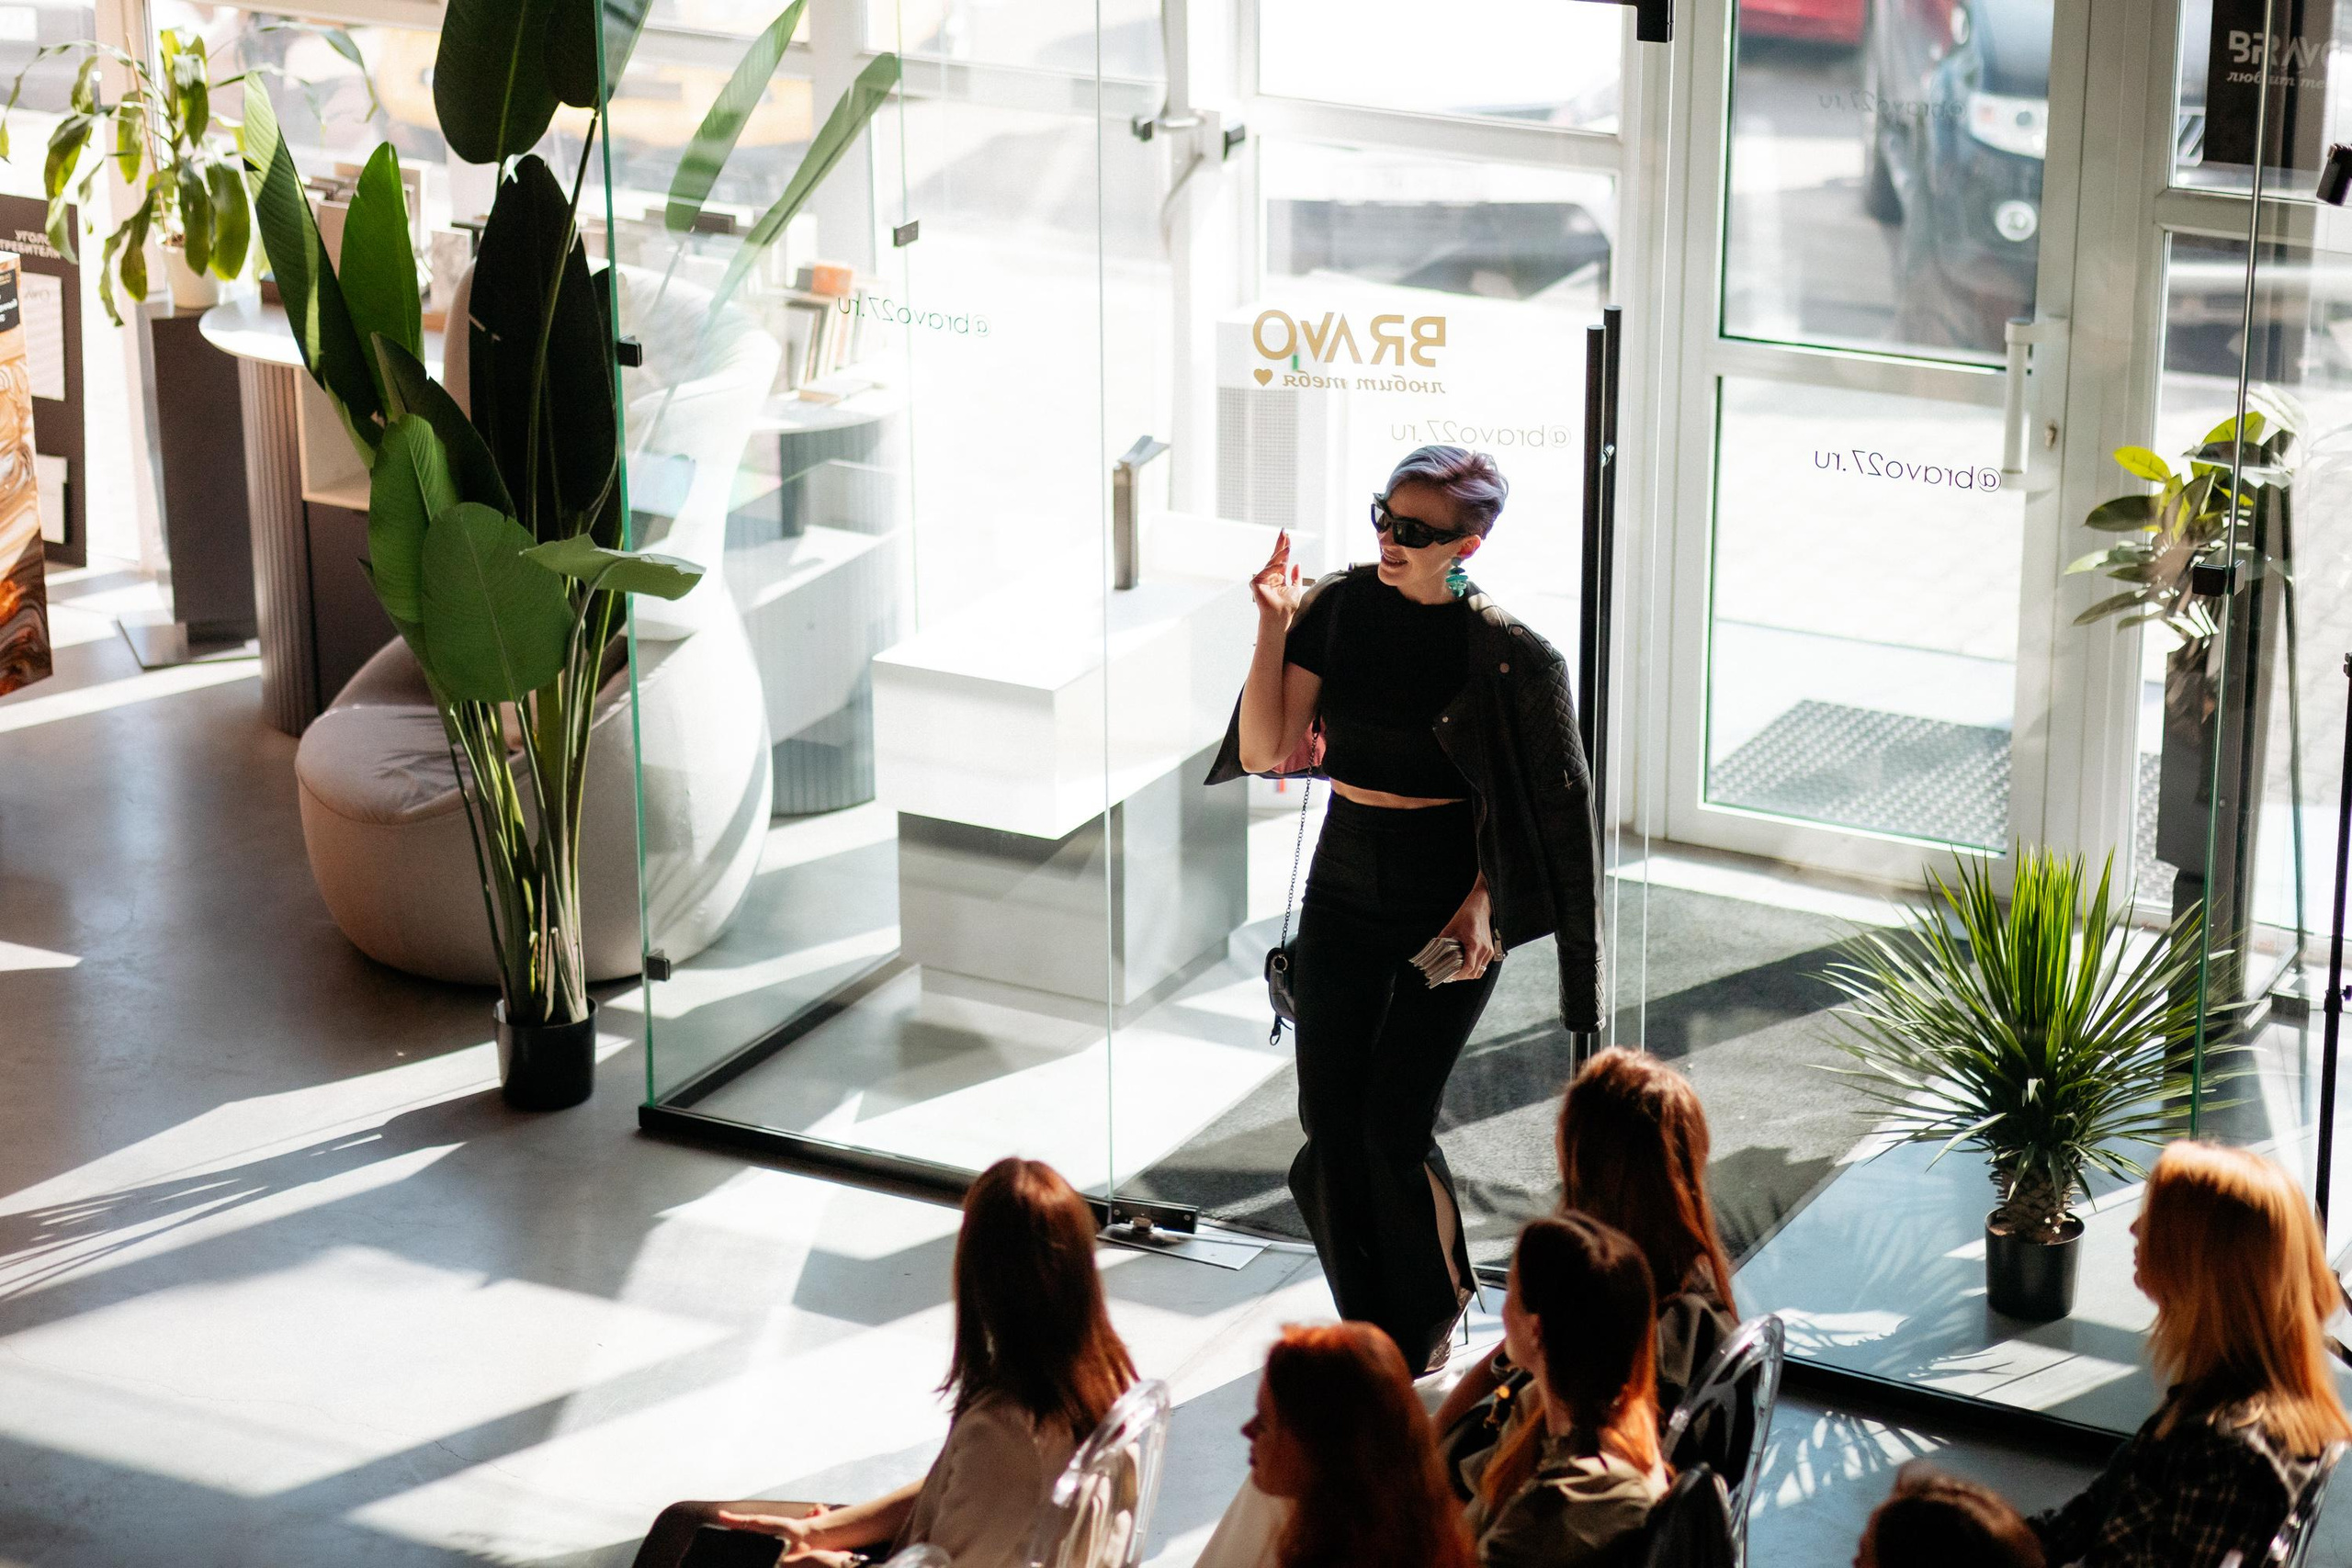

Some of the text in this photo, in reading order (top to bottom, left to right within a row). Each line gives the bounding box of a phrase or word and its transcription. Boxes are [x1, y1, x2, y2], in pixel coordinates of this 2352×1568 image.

[2299, 76, 2332, 89] те
[15, 230, 51, 246] УГОЛ
[0, 239, 61, 259] ТРЕБИТЕЛЯ
